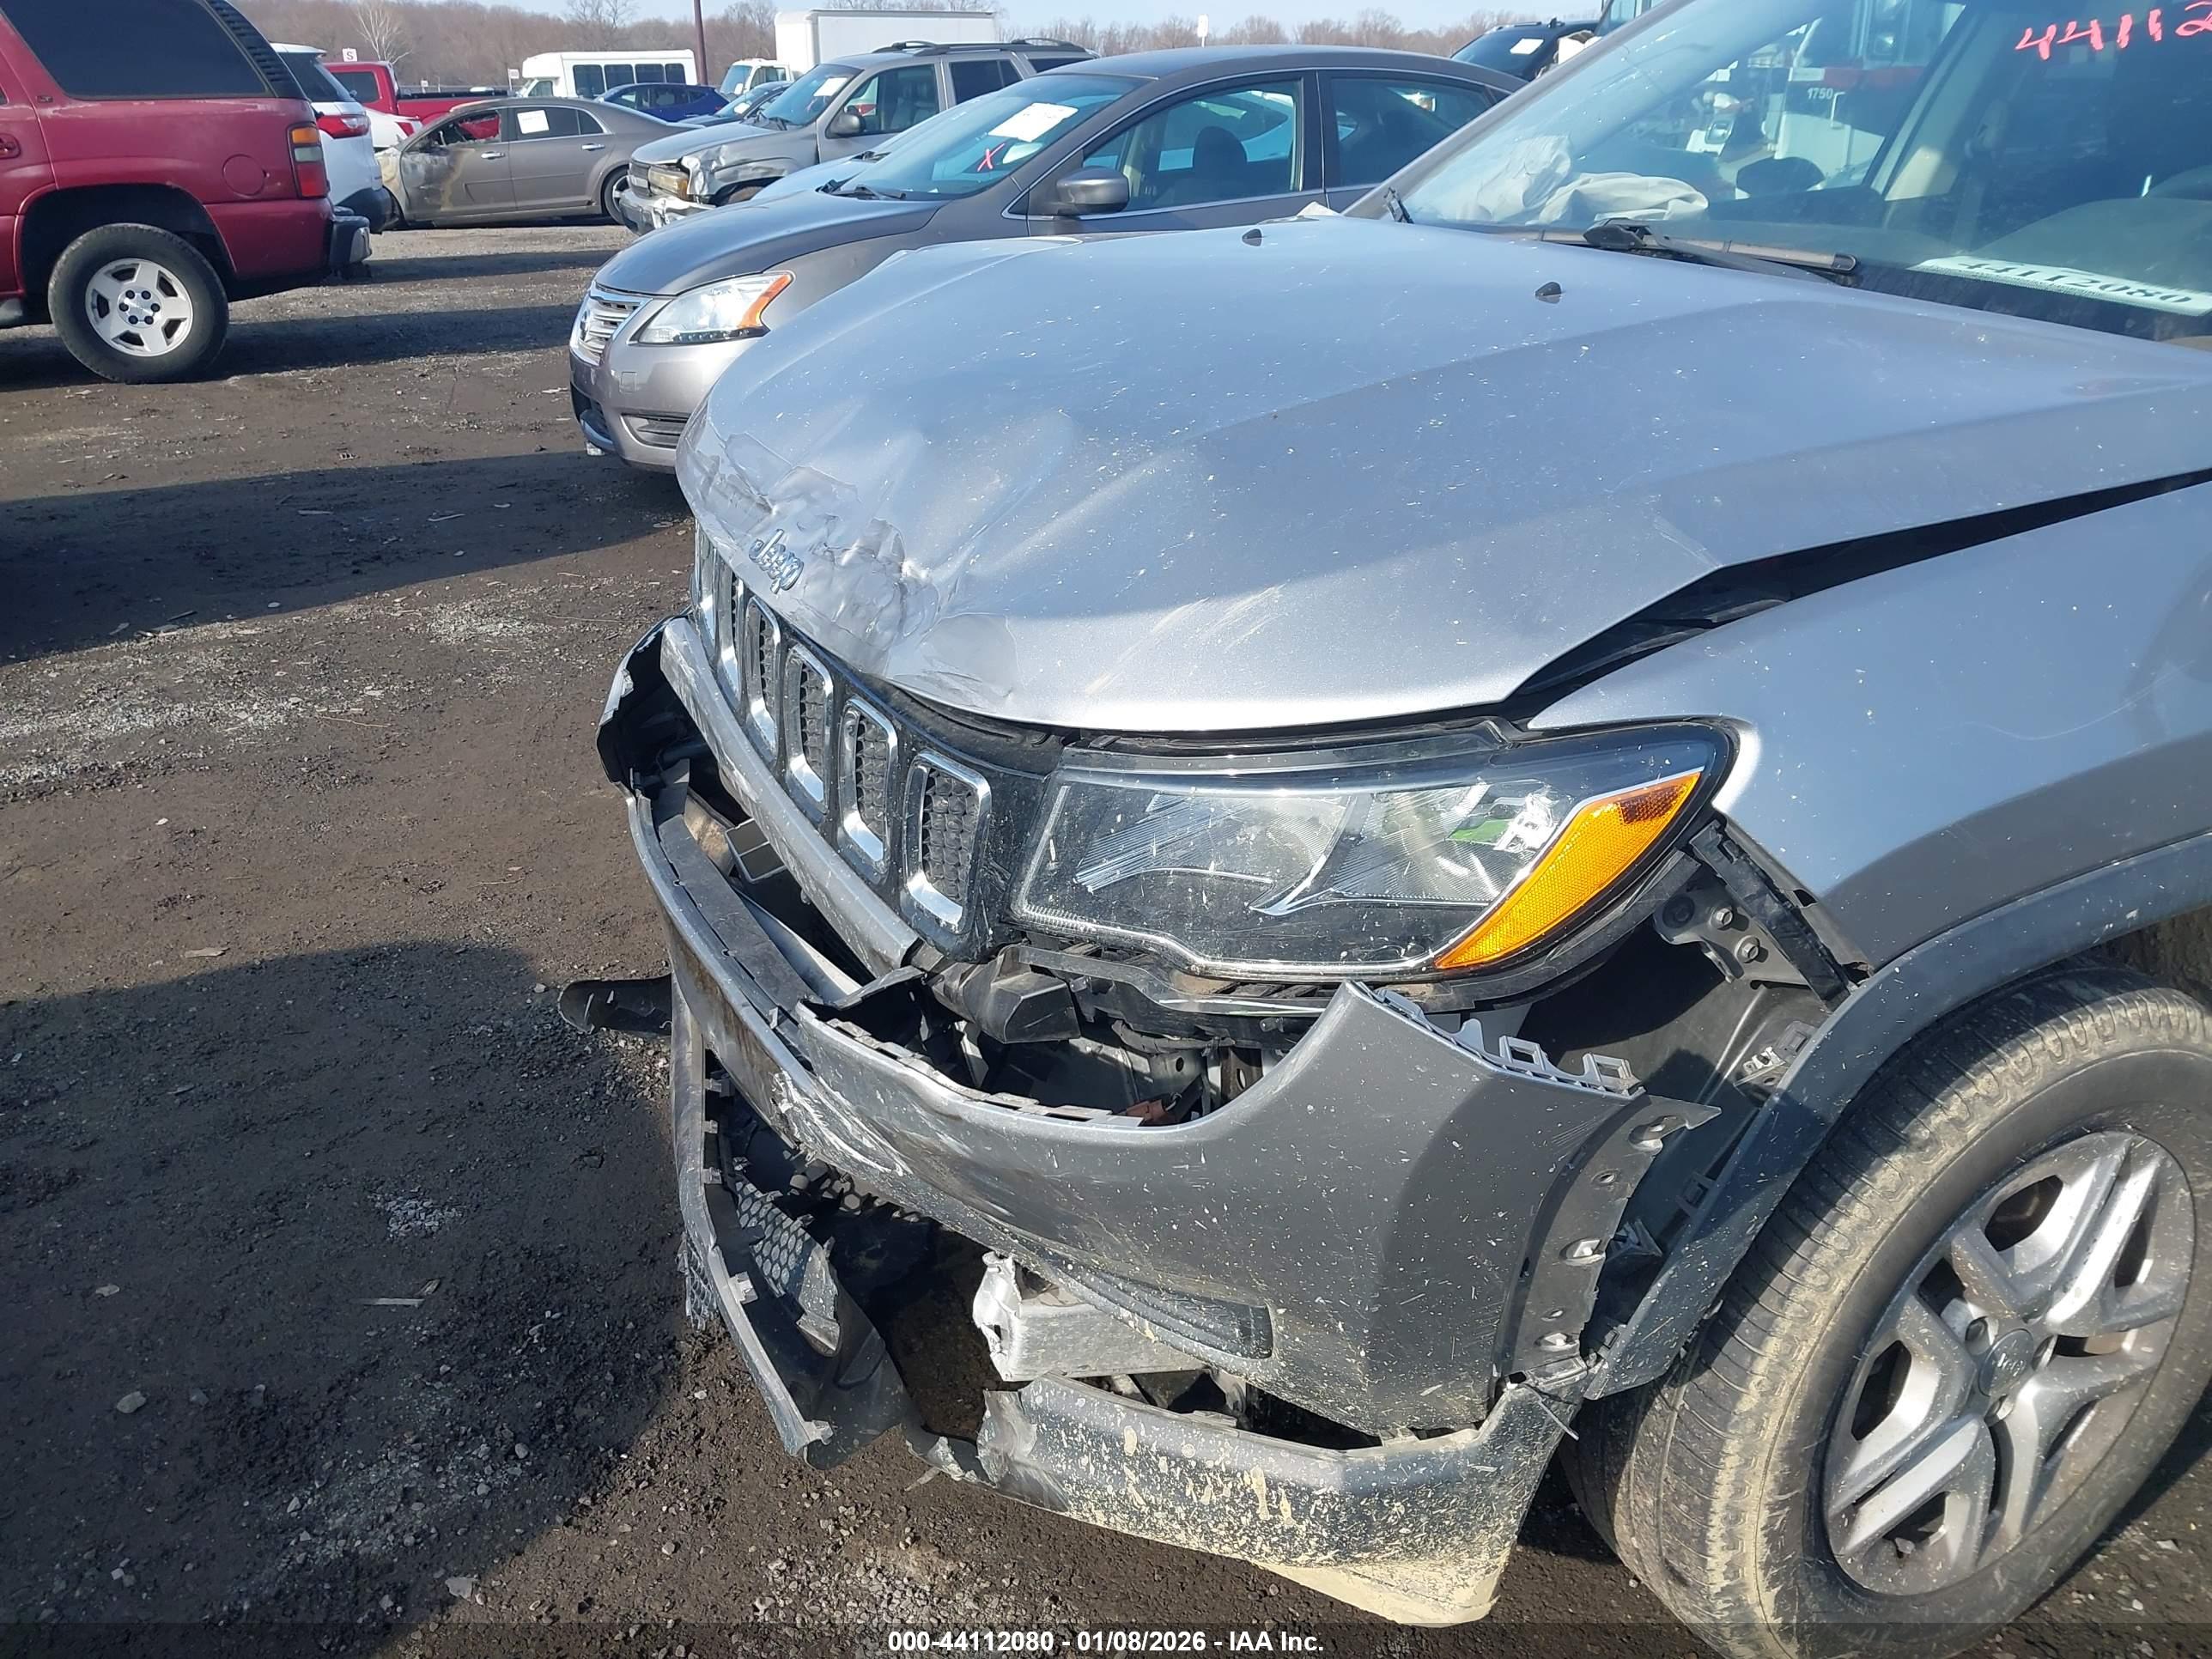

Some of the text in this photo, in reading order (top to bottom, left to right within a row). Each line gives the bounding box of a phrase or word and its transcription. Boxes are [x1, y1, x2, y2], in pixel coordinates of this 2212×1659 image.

[346, 51, 354, 60] S
[1807, 88, 1833, 100] 1750
[749, 528, 805, 594] Jeep
